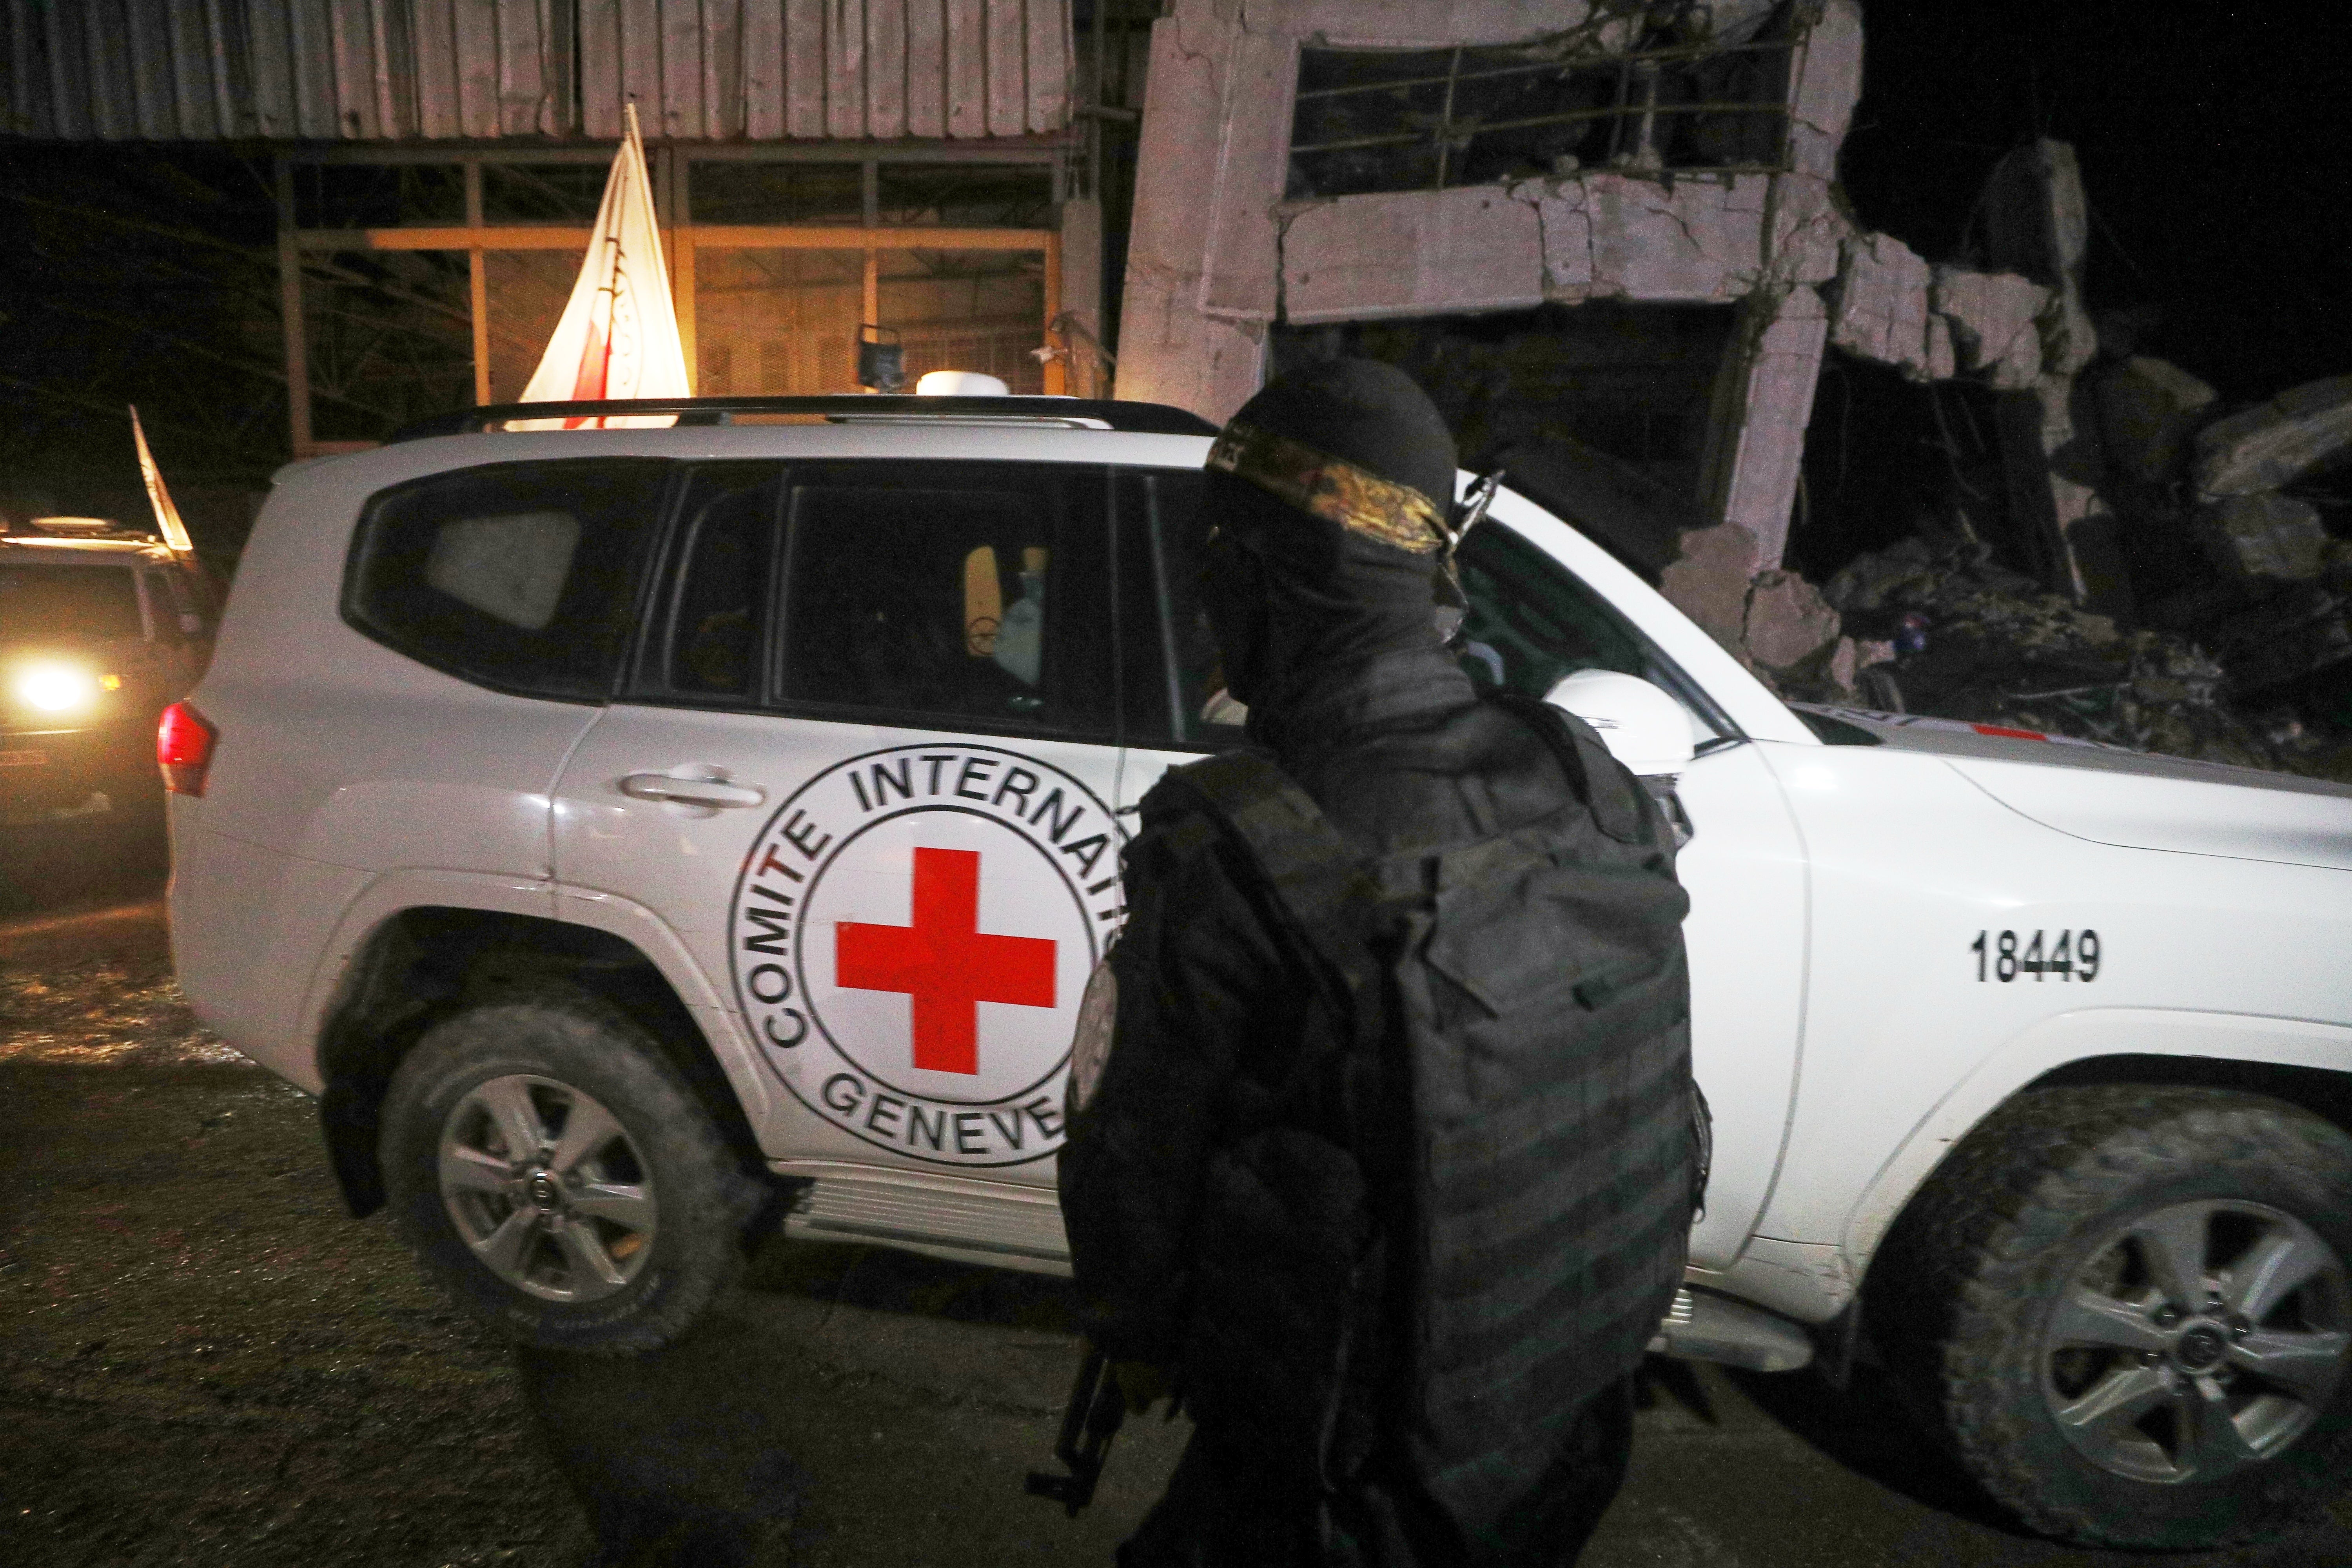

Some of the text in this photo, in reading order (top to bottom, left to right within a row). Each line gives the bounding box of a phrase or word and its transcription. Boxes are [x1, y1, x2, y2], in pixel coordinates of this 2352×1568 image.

[742, 755, 1132, 1048] COMITE INTERNATI
[1969, 929, 2101, 982] 18449
[822, 1072, 1065, 1154] GENEVE
